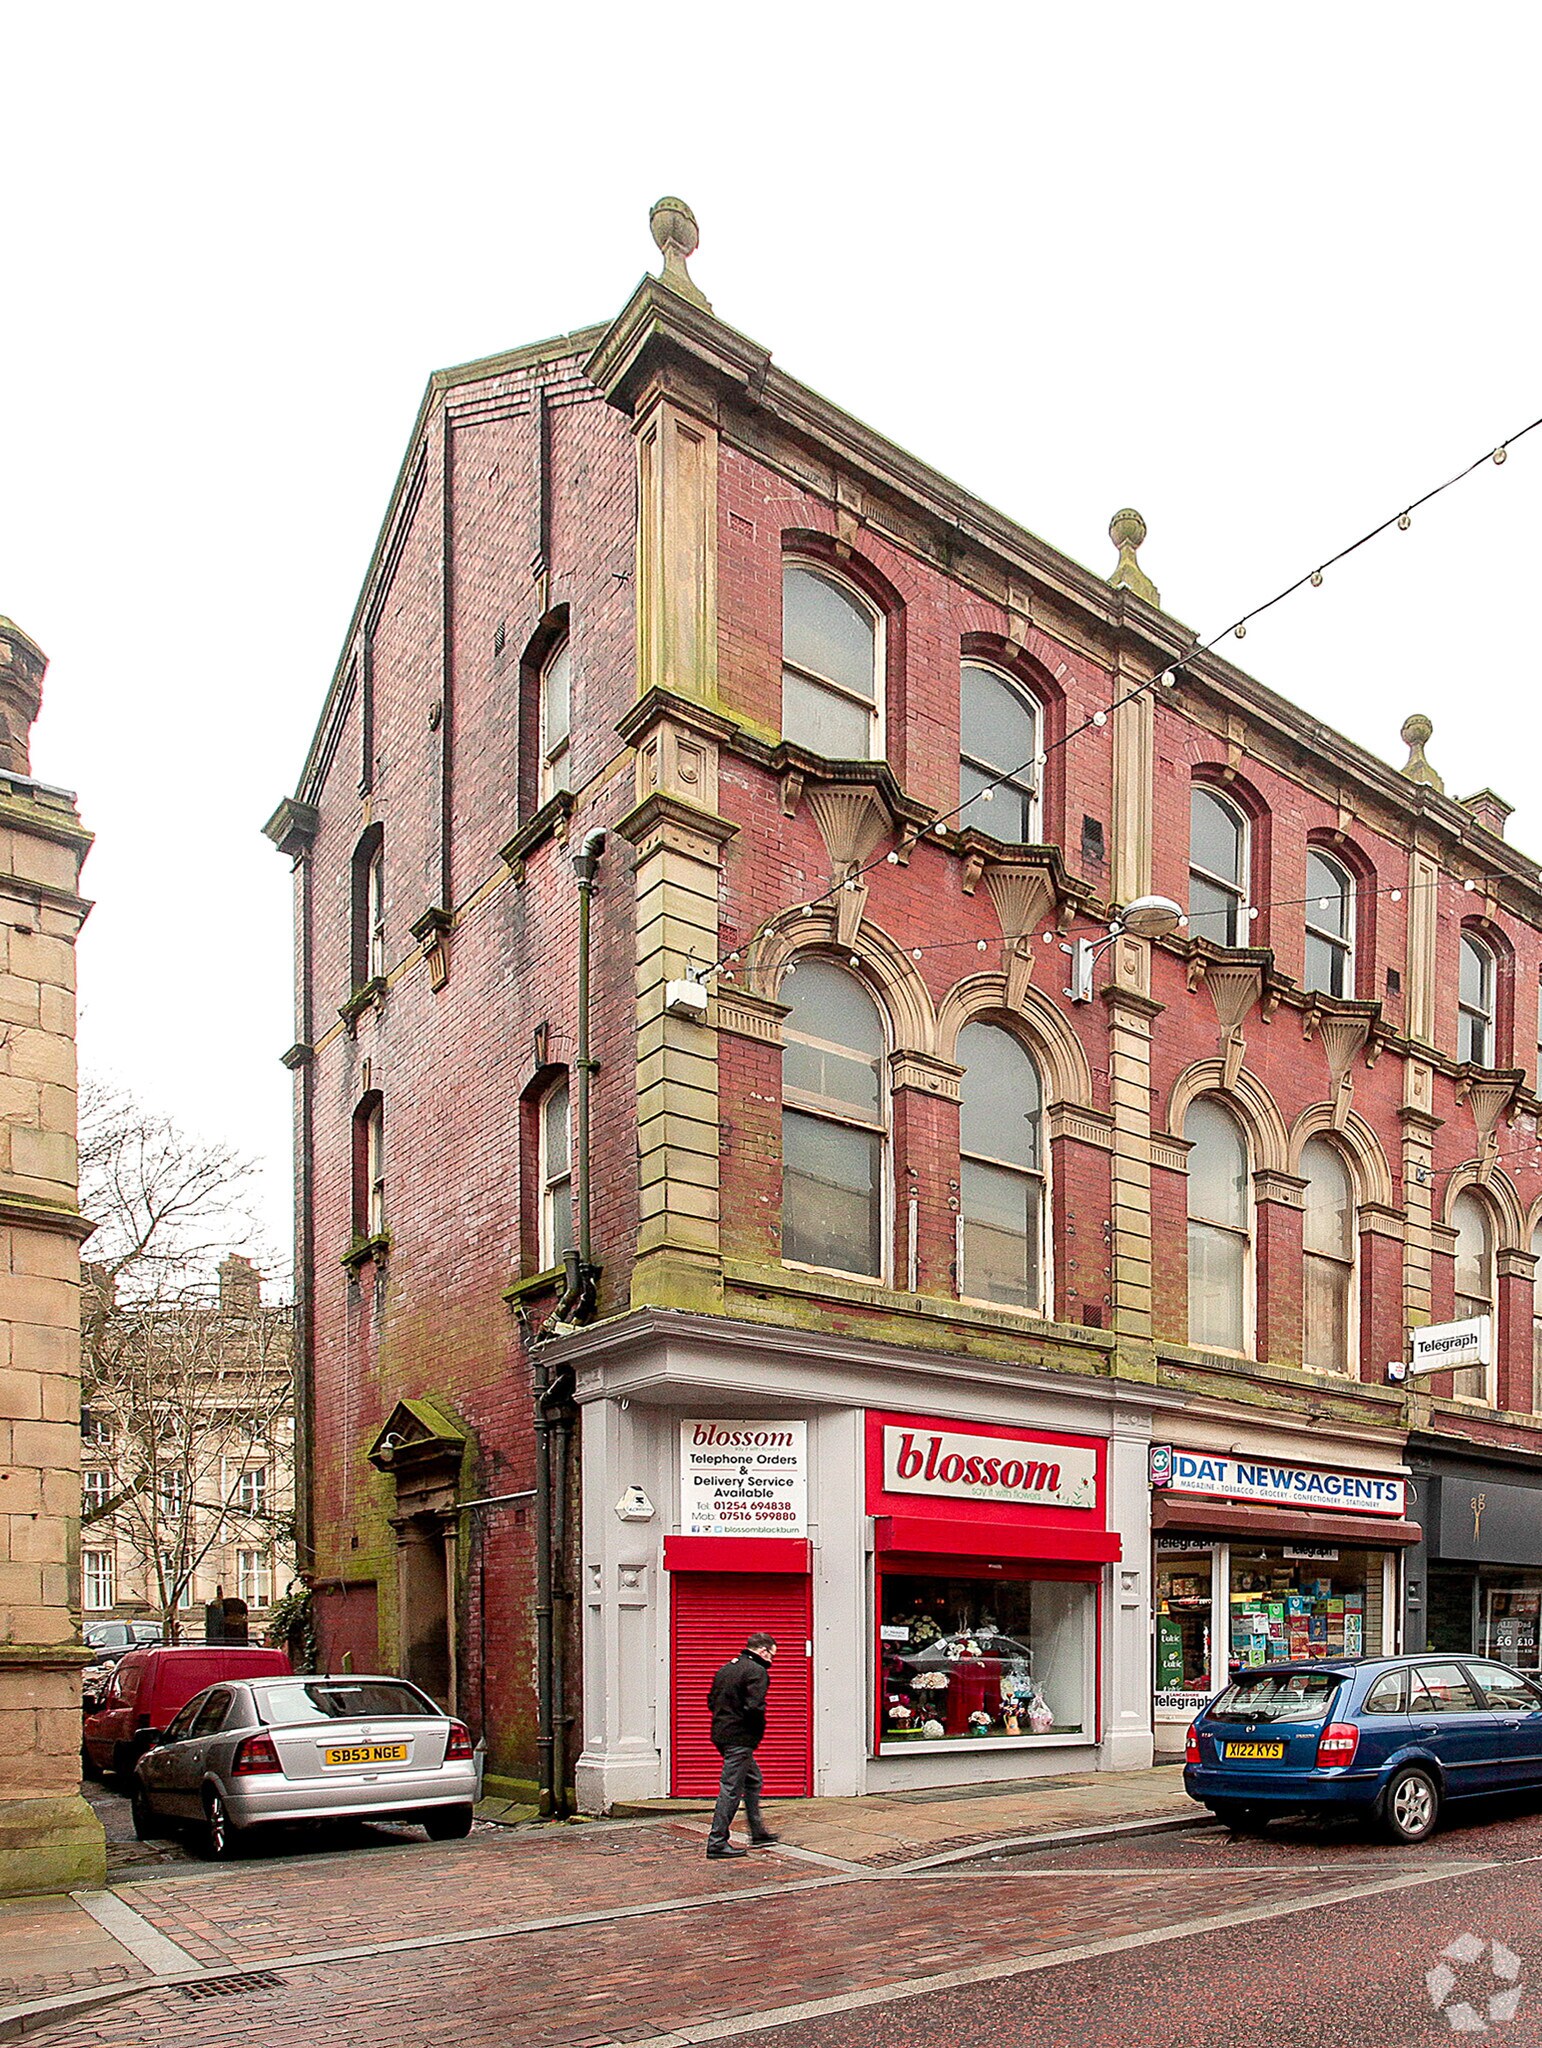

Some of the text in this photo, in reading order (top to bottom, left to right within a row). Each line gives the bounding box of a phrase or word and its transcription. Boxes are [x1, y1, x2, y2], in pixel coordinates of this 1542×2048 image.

[1418, 1333, 1478, 1353] Telegraph
[693, 1424, 793, 1447] blossom
[690, 1454, 797, 1465] Telephone Orders
[897, 1433, 1061, 1491] blossom
[739, 1466, 748, 1475] &
[694, 1476, 794, 1487] Delivery Service
[1237, 1464, 1398, 1501] NEWSAGENTS
[714, 1488, 774, 1498] Available
[1180, 1481, 1215, 1490] MAGAZINE
[1260, 1489, 1287, 1499] GROCERY
[1294, 1493, 1341, 1504] CONFECTIONERY
[1346, 1499, 1380, 1508] STATIONERY
[714, 1501, 747, 1510] 01254
[750, 1501, 791, 1510] 694838
[720, 1511, 752, 1520] 07516
[755, 1511, 796, 1520] 599880
[1496, 1636, 1534, 1646] £6 £10
[332, 1746, 400, 1763] SB53 NGE
[1230, 1744, 1279, 1757] X122 KYS
